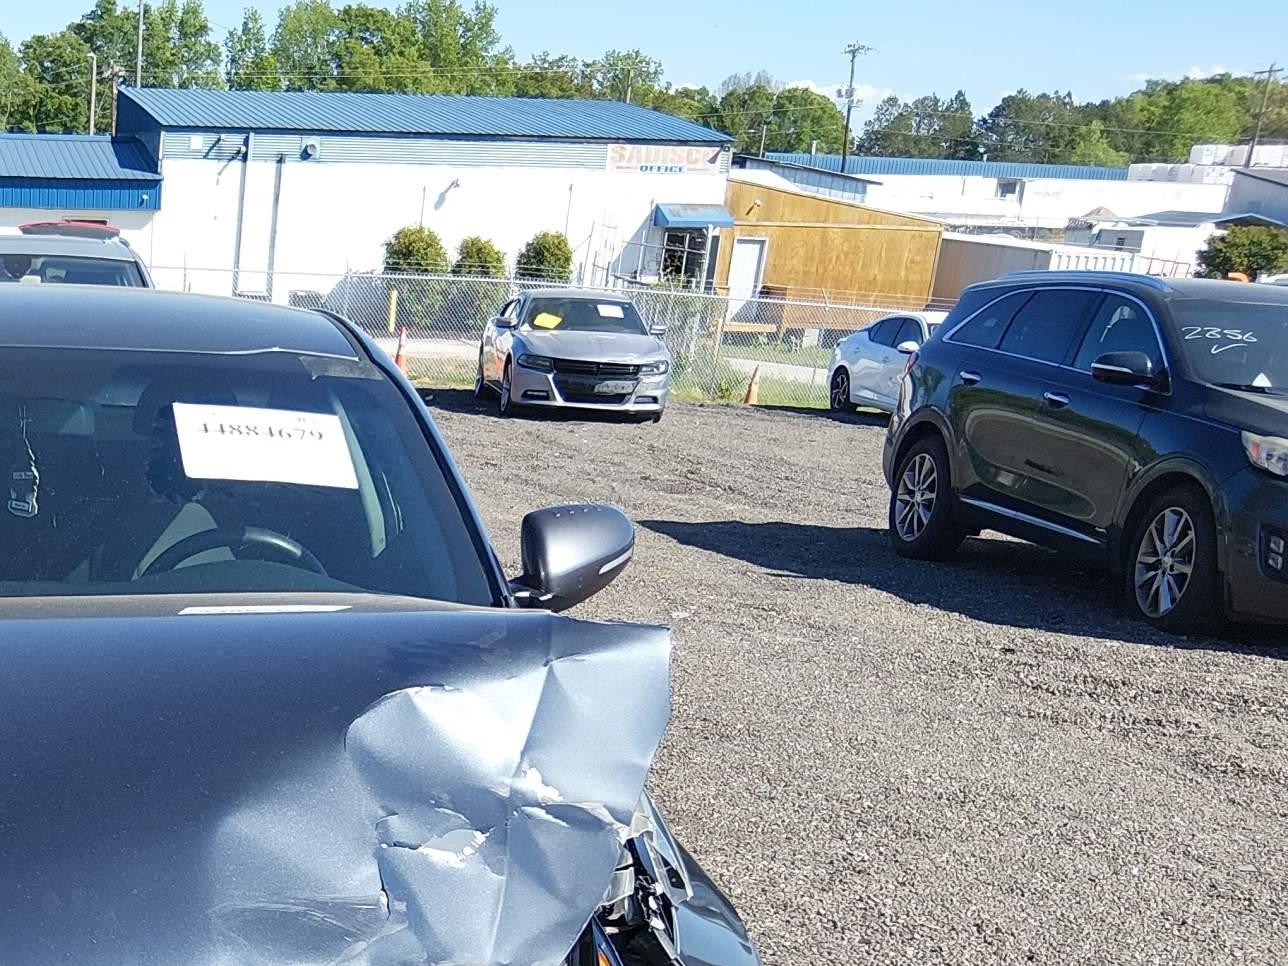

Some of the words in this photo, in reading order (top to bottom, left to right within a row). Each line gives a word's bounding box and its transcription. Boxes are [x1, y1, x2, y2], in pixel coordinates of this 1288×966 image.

[639, 165, 686, 174] OFFICE
[1181, 326, 1258, 342] 2856
[195, 422, 324, 441] 44884679
